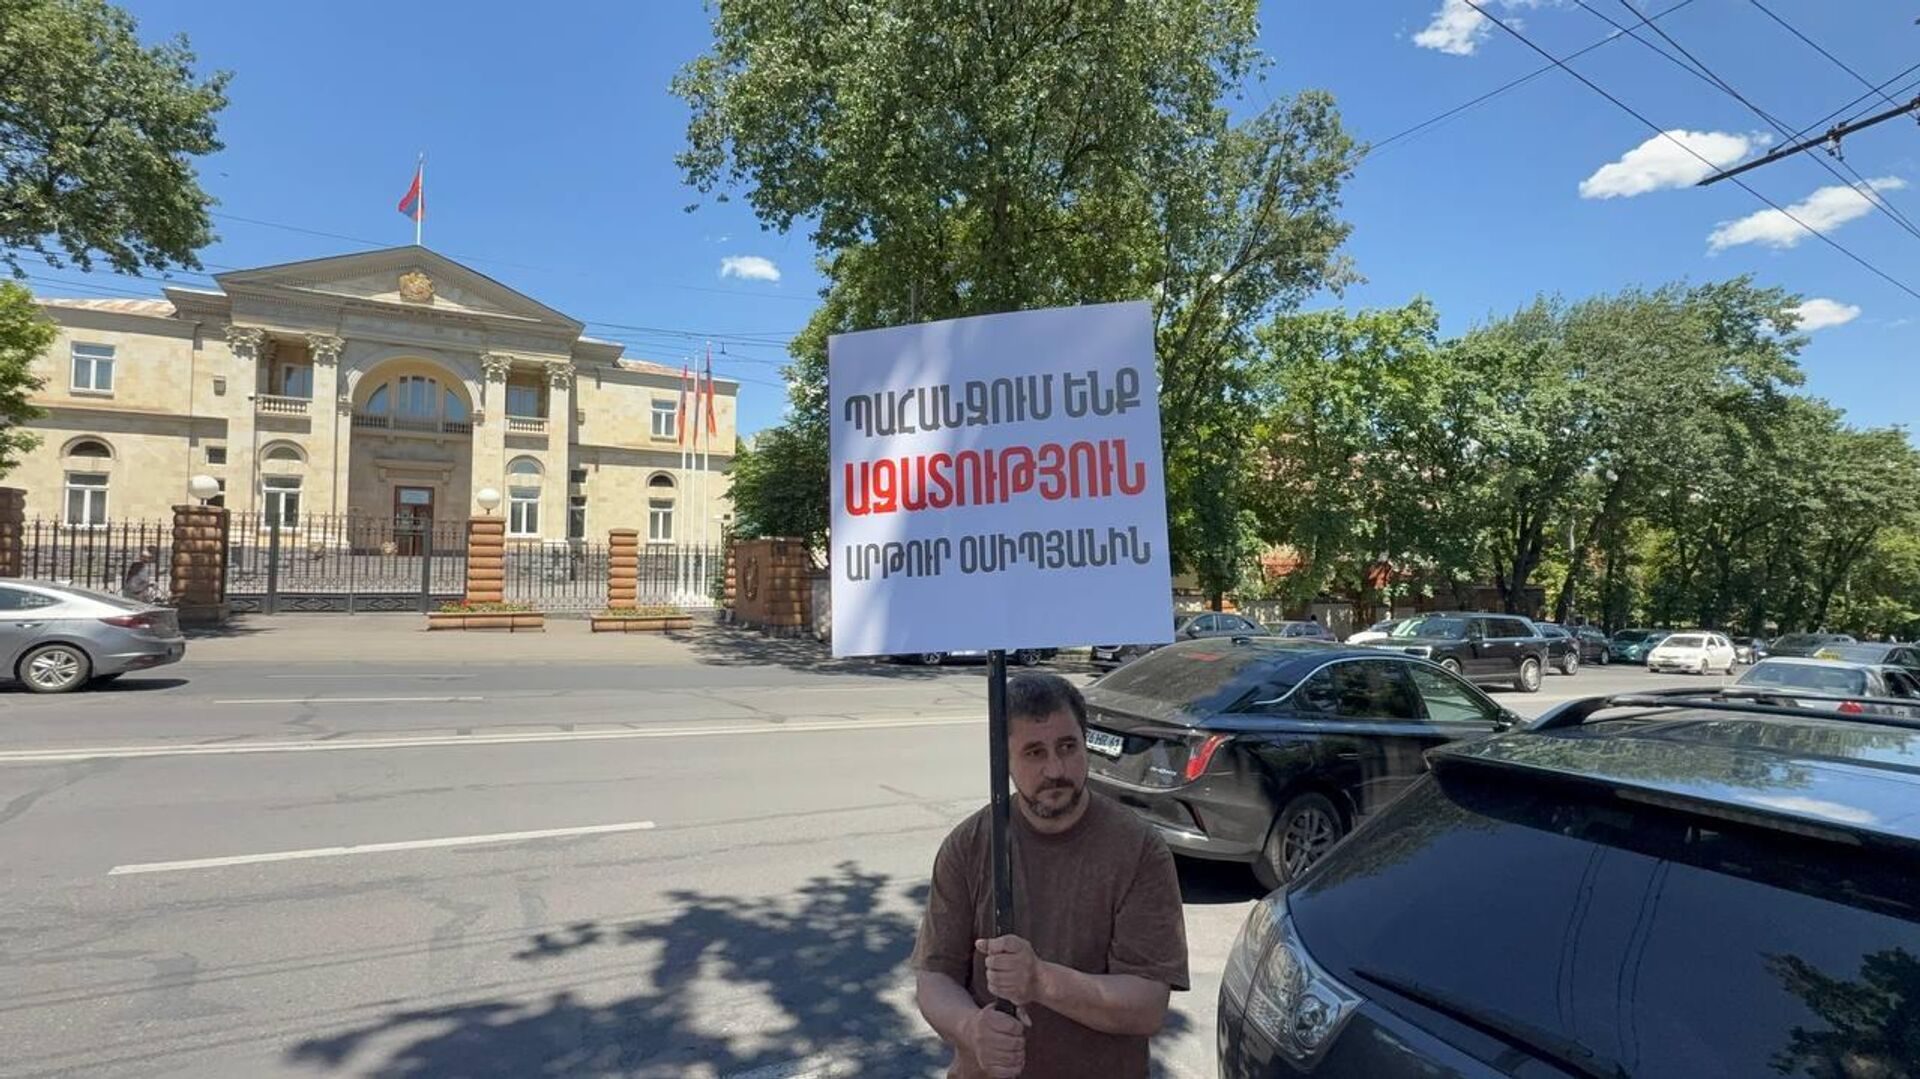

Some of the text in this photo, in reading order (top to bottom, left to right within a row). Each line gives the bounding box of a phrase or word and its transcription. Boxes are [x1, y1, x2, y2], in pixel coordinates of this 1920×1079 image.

[844, 367, 1140, 437] ՊԱՀԱՆՋՈՒՄ ԵՆՔ
[844, 438, 1146, 516] ԱԶԱՏՈՒԹՅՈՒՆ
[846, 526, 1150, 582] ԱՐԹՈՒՐ ՕՍԻՊՅԱՆԻՆ
